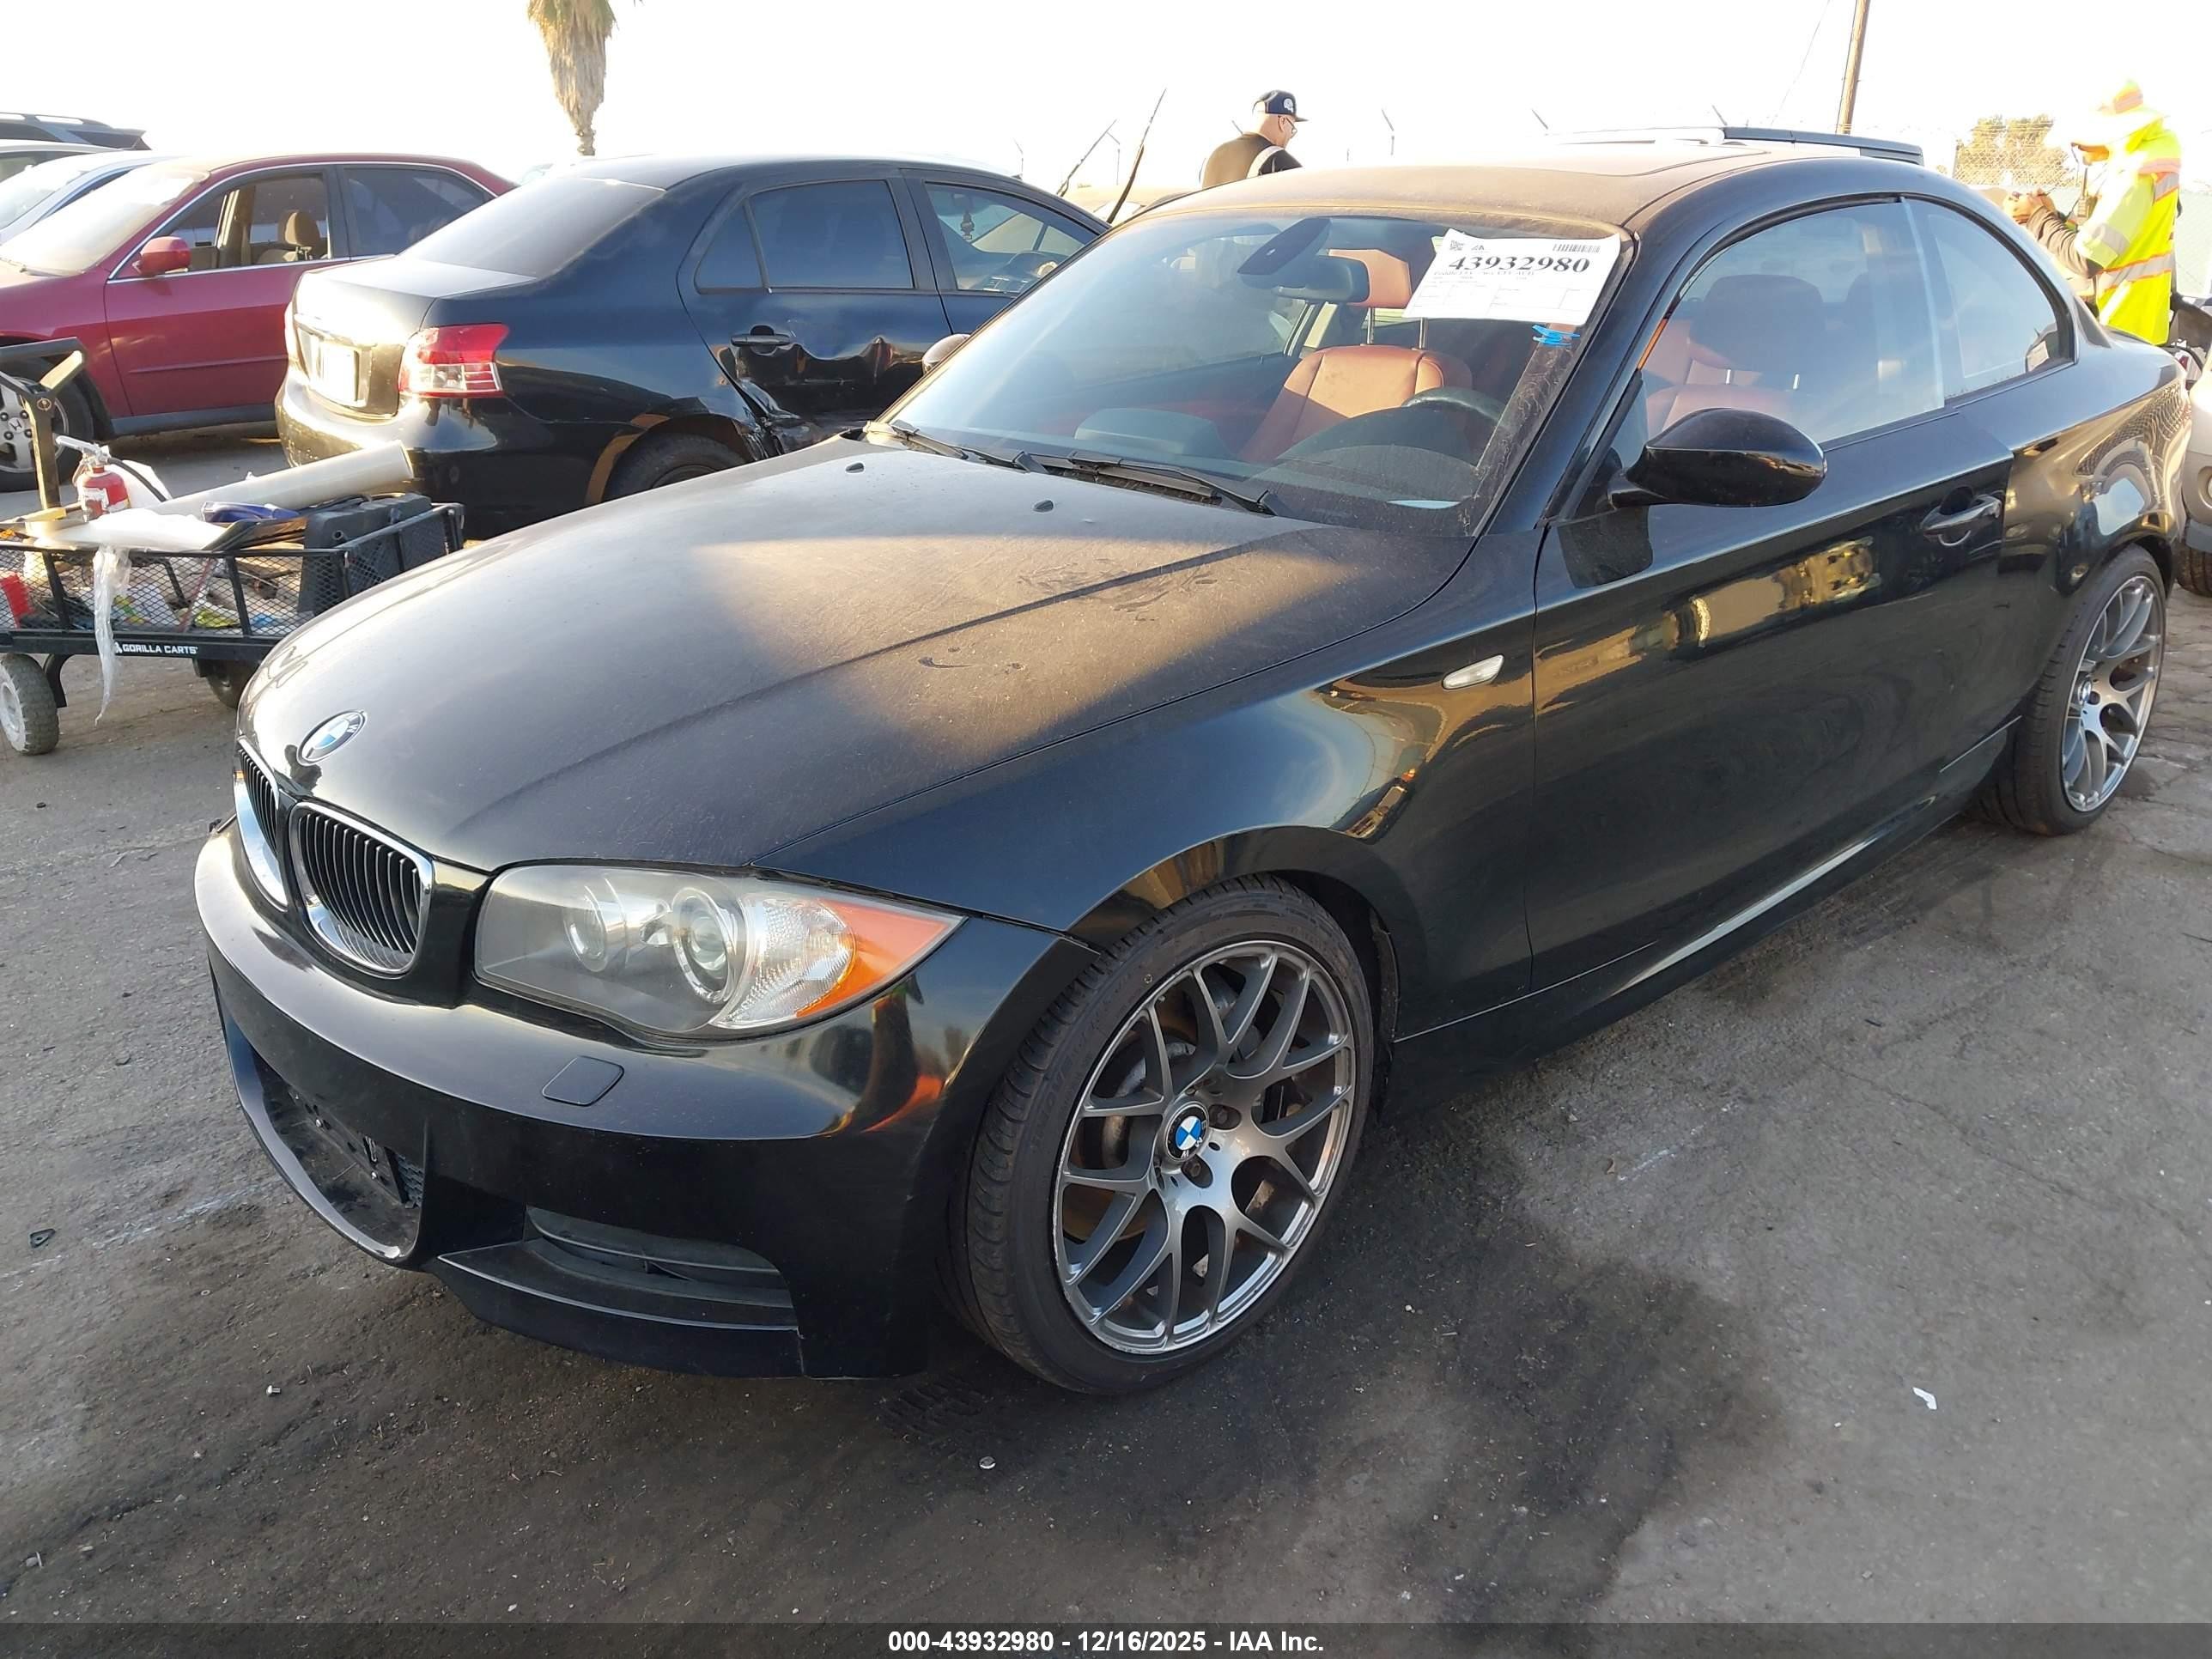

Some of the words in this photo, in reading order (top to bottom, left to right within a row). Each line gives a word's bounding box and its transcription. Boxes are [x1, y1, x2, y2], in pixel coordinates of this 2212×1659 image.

[1449, 256, 1590, 272] 43932980
[122, 643, 162, 653] GORILLA
[164, 645, 198, 654] CARTS
